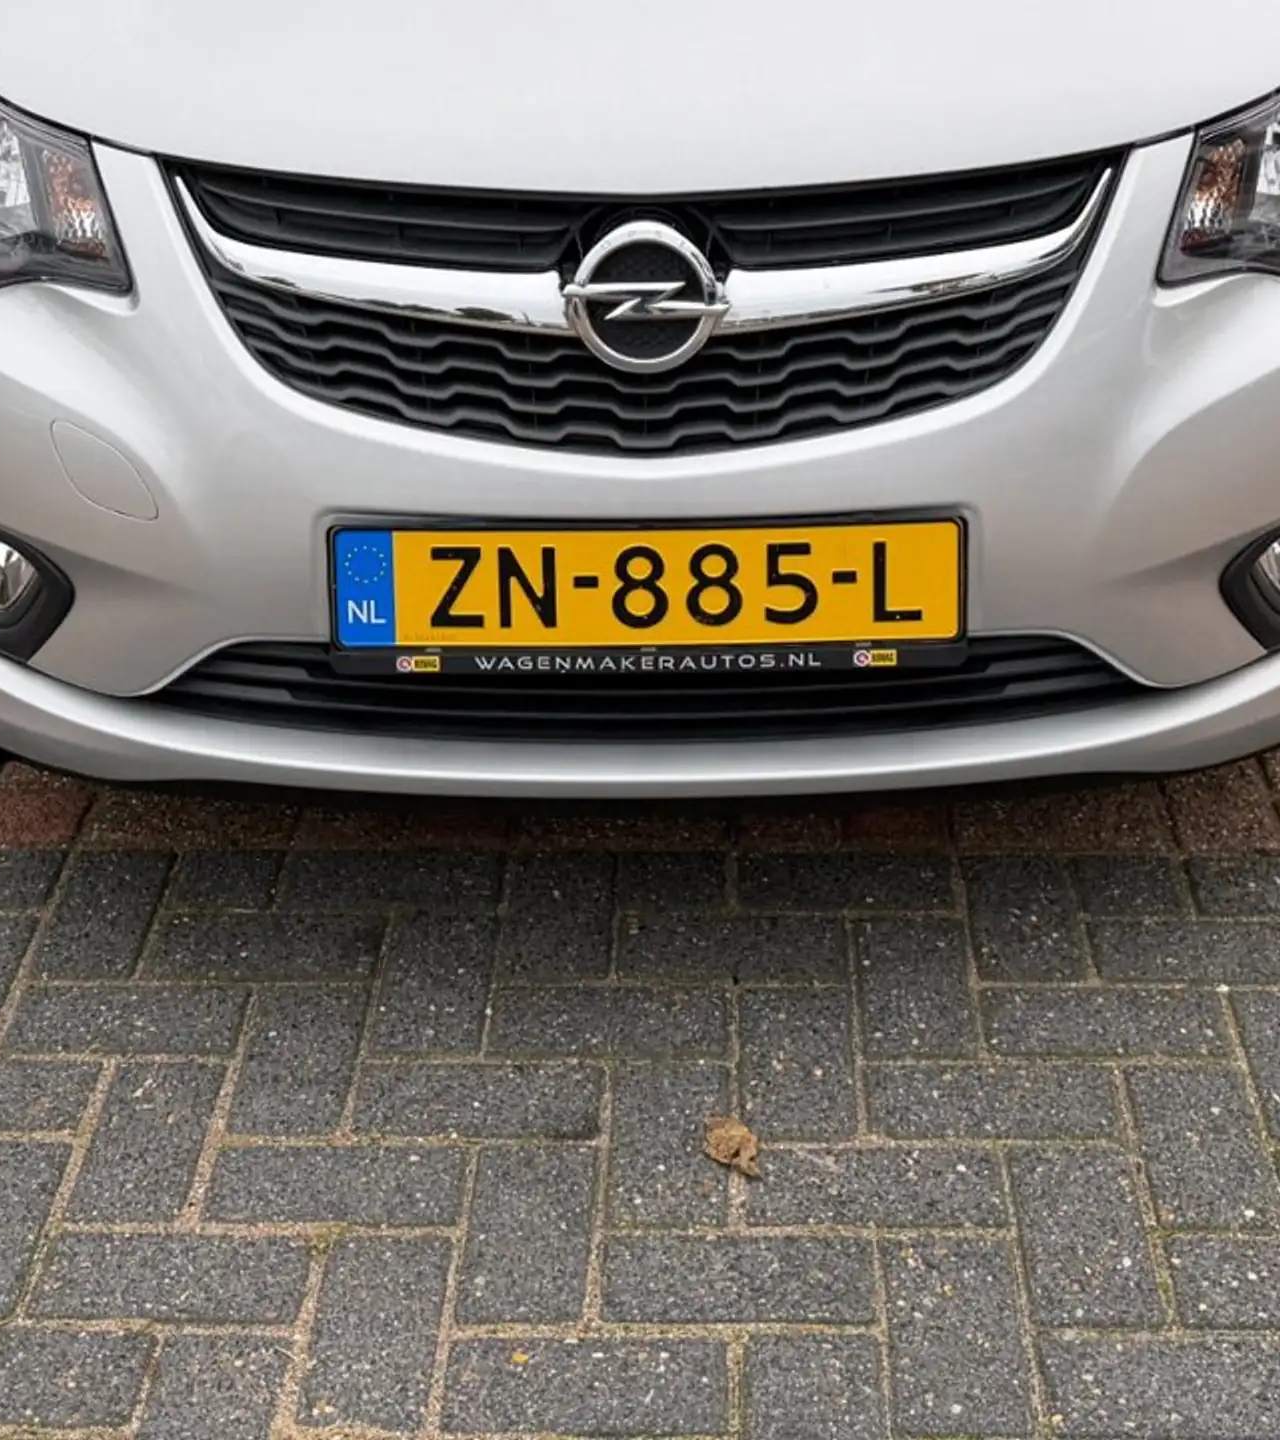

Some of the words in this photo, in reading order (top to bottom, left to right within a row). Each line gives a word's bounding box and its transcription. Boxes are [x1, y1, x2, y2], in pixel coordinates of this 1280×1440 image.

[346, 599, 387, 624] NL
[429, 541, 924, 629] ZN-885-L
[474, 651, 822, 672] WAGENMAKERAUTOS.NL
